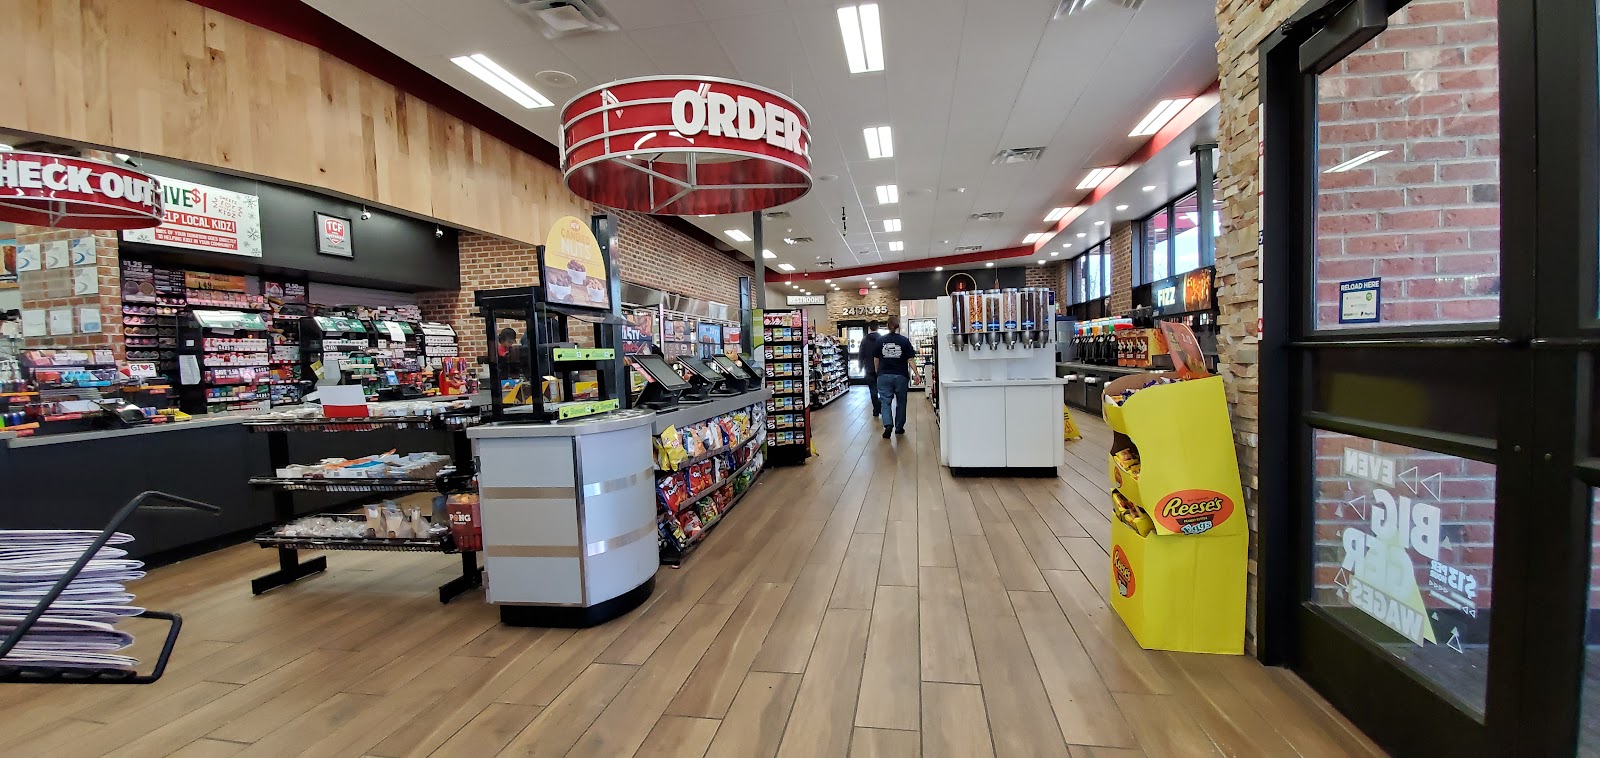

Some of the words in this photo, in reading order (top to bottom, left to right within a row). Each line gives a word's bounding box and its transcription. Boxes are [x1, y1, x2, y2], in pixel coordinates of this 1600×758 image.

[672, 89, 803, 155] ORDER
[0, 159, 94, 194] HECK
[100, 171, 154, 206] OUT
[163, 185, 193, 208] IVE
[163, 211, 179, 222] ELP
[181, 214, 211, 228] LOCAL
[212, 219, 236, 233] KIDZ!
[326, 221, 343, 232] TCF
[560, 238, 591, 260] NUTS
[1341, 282, 1363, 291] RELOAD
[1363, 280, 1380, 289] HERE
[789, 296, 823, 304] RESTROOMS
[1157, 286, 1176, 307] FIZZ
[621, 325, 640, 340] ASTY
[449, 513, 471, 522] PONG
[1162, 496, 1223, 518] Reese's
[1181, 520, 1213, 535] Eggs
